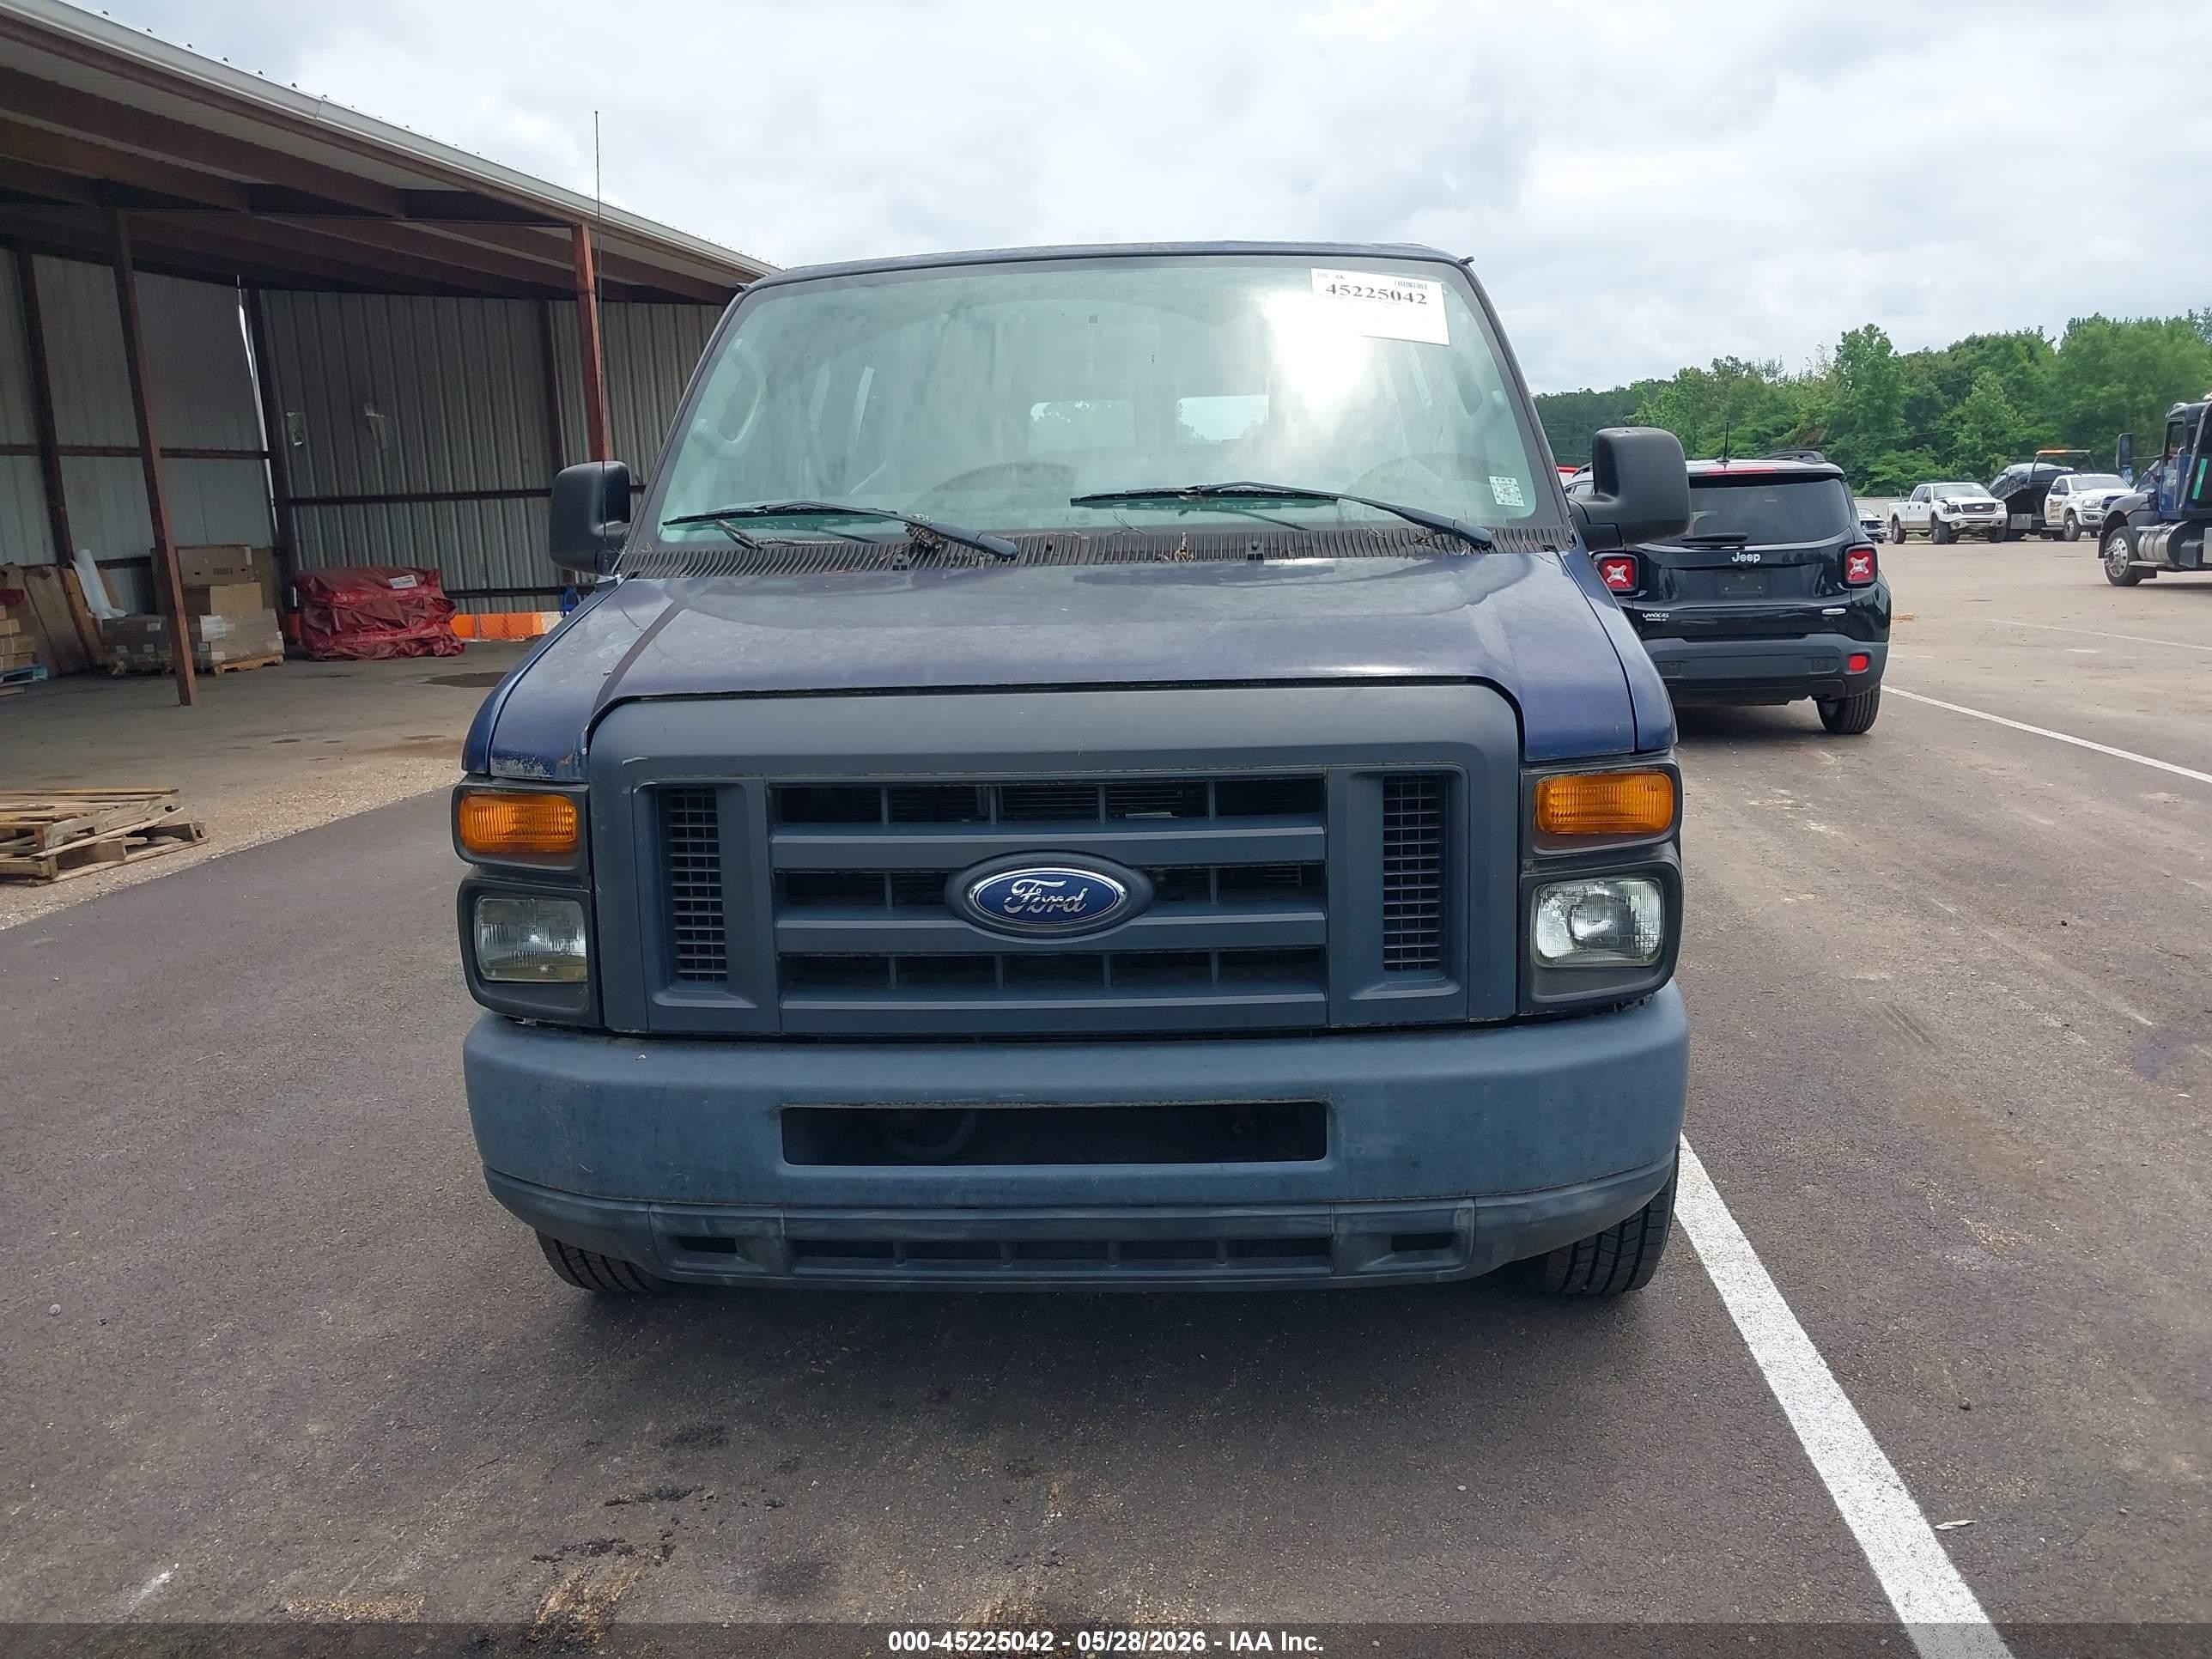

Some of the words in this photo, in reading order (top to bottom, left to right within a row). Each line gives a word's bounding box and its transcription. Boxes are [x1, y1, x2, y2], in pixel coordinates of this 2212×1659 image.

[1325, 283, 1428, 305] 45225042
[1731, 551, 1761, 563] Jeep
[1003, 878, 1089, 914] Ford
